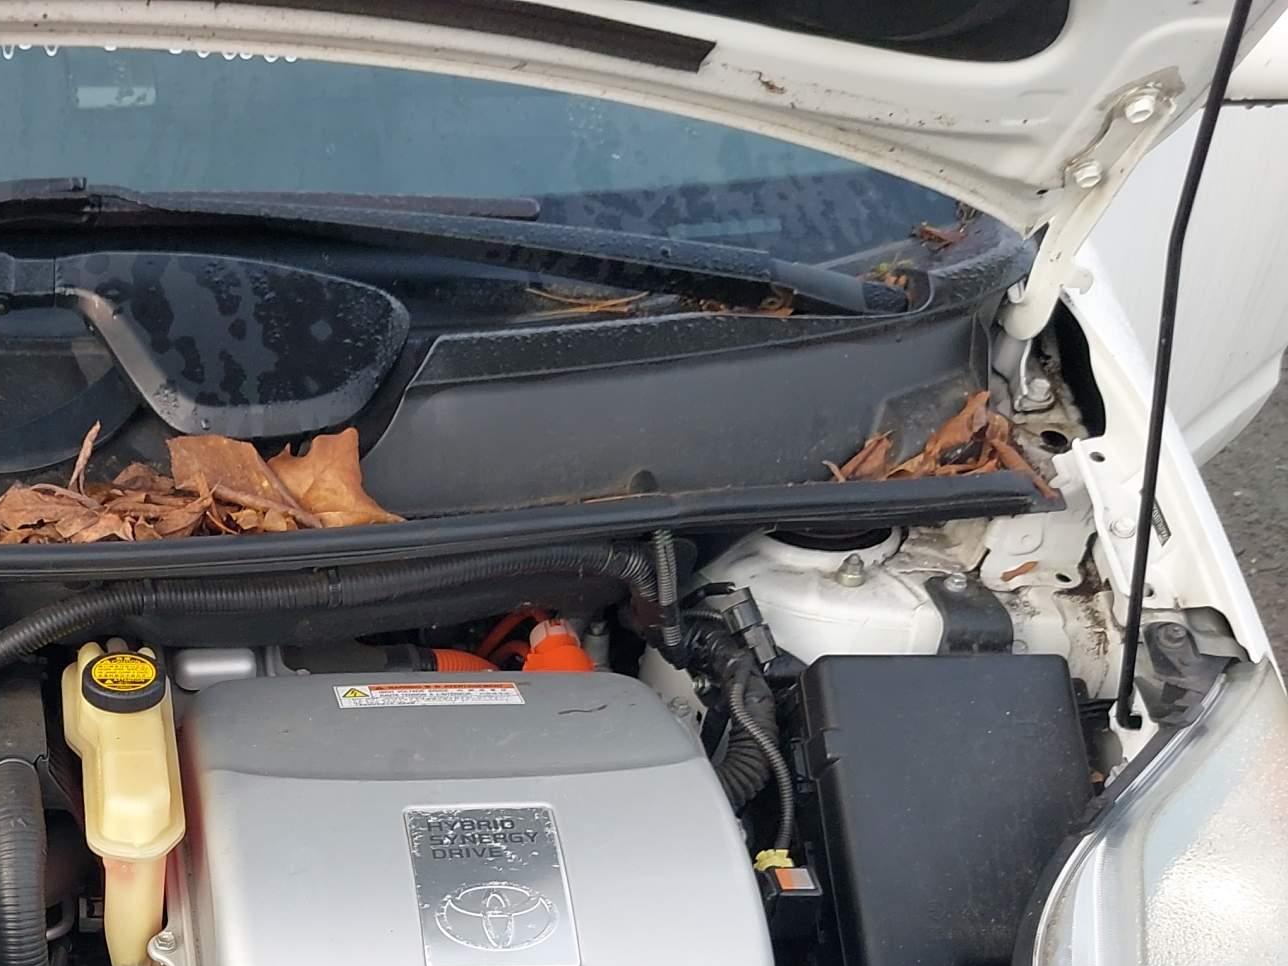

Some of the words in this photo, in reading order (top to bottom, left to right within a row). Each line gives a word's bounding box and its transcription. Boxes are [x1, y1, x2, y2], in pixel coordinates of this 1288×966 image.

[426, 818, 515, 832] HYBRID
[428, 832, 539, 846] SYNERGY
[431, 846, 503, 860] DRIVE
